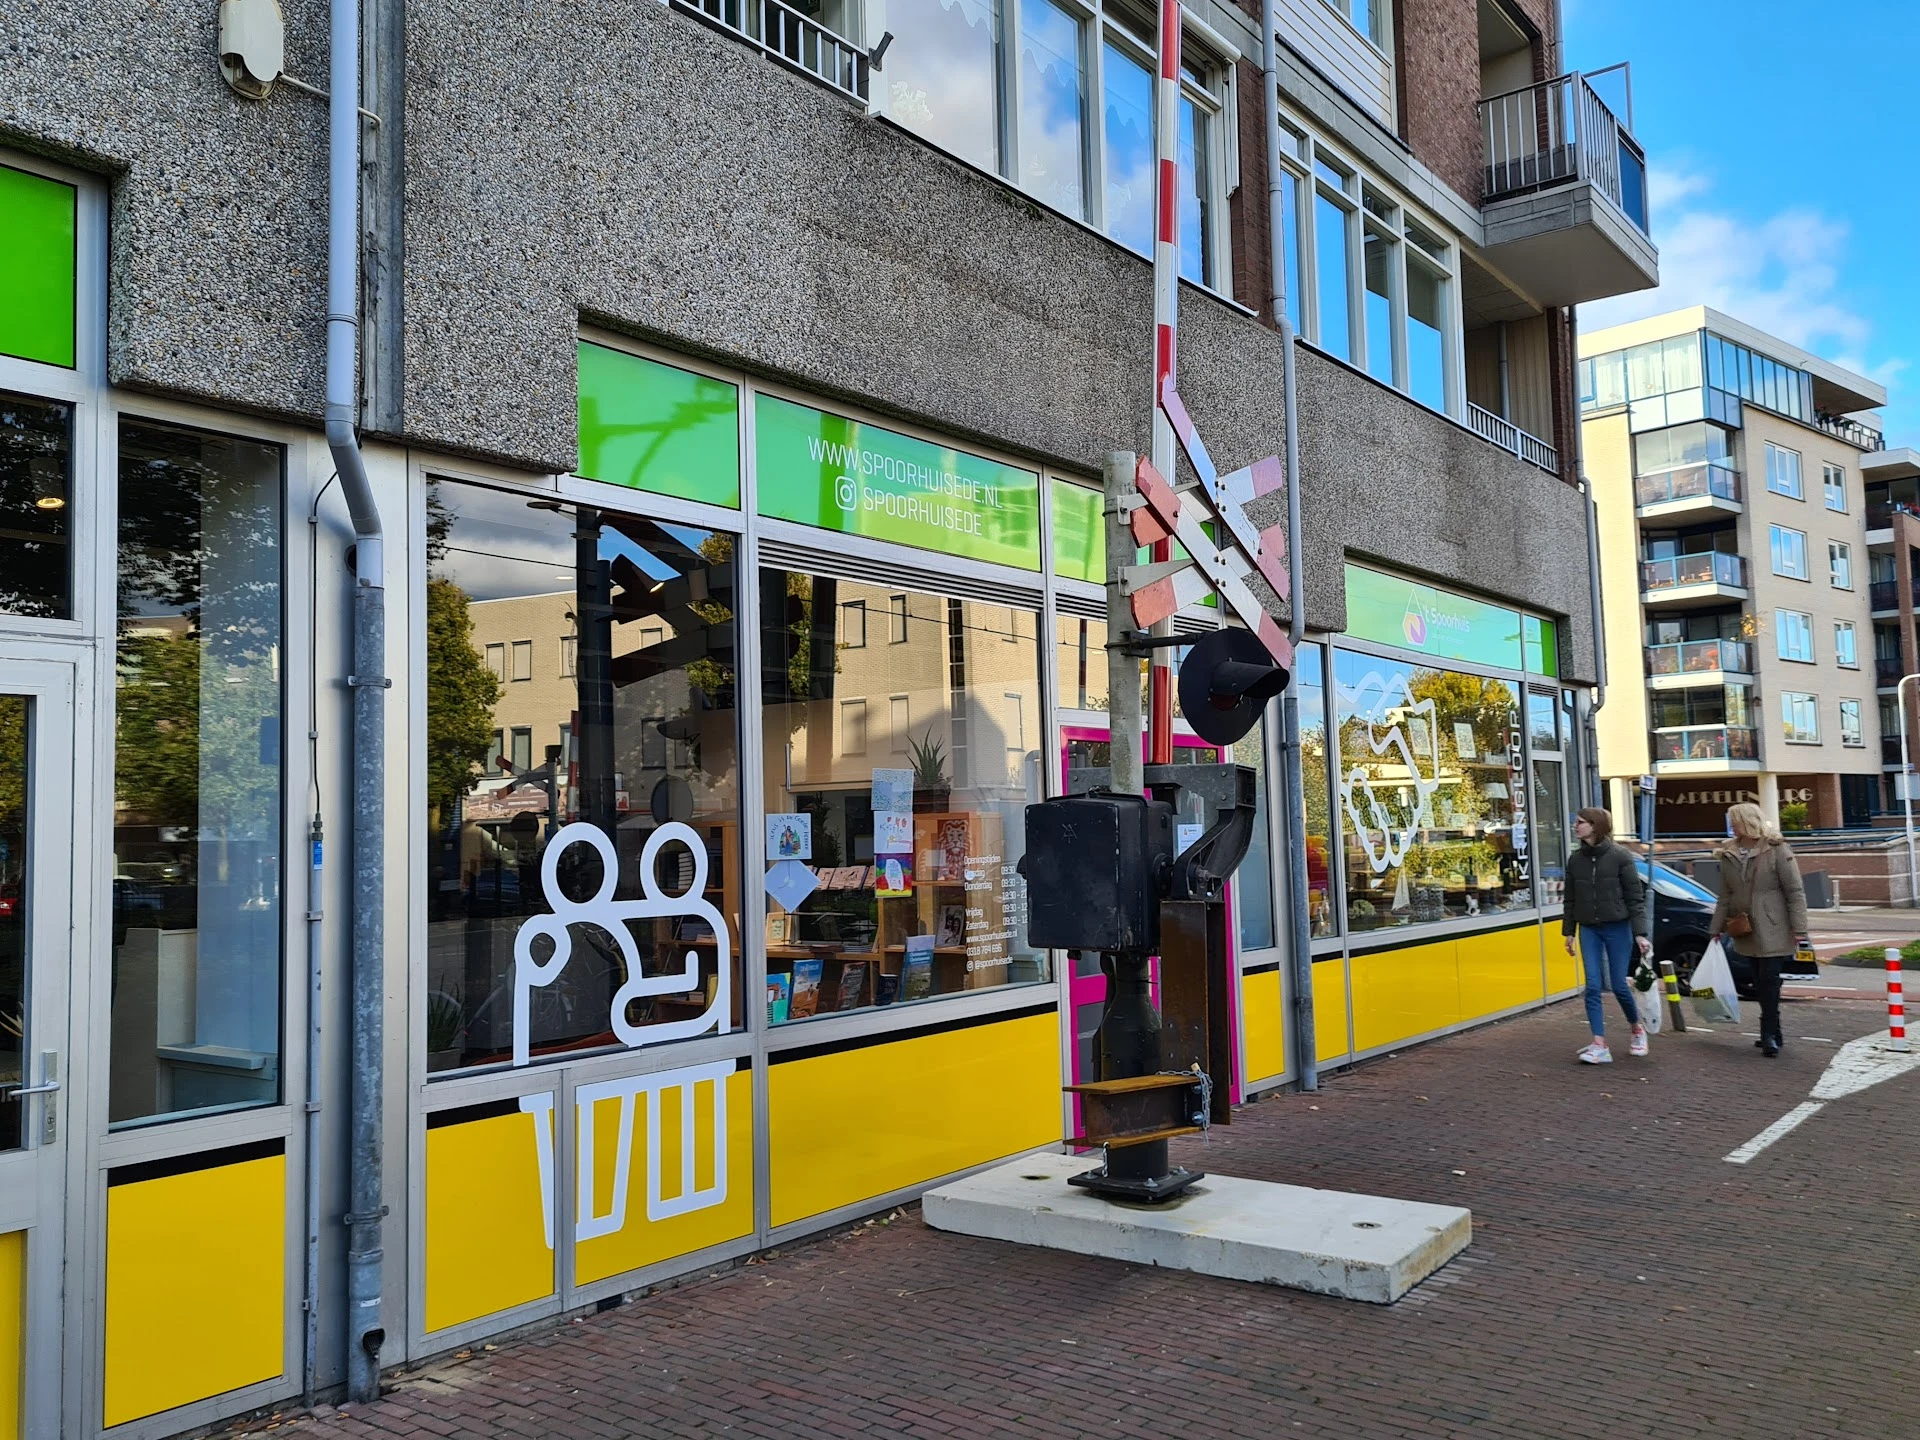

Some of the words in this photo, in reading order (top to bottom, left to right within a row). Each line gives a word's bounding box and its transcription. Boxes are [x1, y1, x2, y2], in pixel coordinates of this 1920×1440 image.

[807, 435, 1003, 509] WWW.SPOORHUISEDE.NL
[863, 487, 982, 536] SPOORHUISEDE
[1431, 607, 1471, 633] Spoorhuis
[1510, 710, 1529, 880] KRINGLOOP
[1676, 788, 1813, 804] APPELENURG
[964, 880, 993, 891] Donderdag
[966, 907, 984, 918] Vrijdag
[966, 929, 1018, 943] www.spoorhuisede.nl
